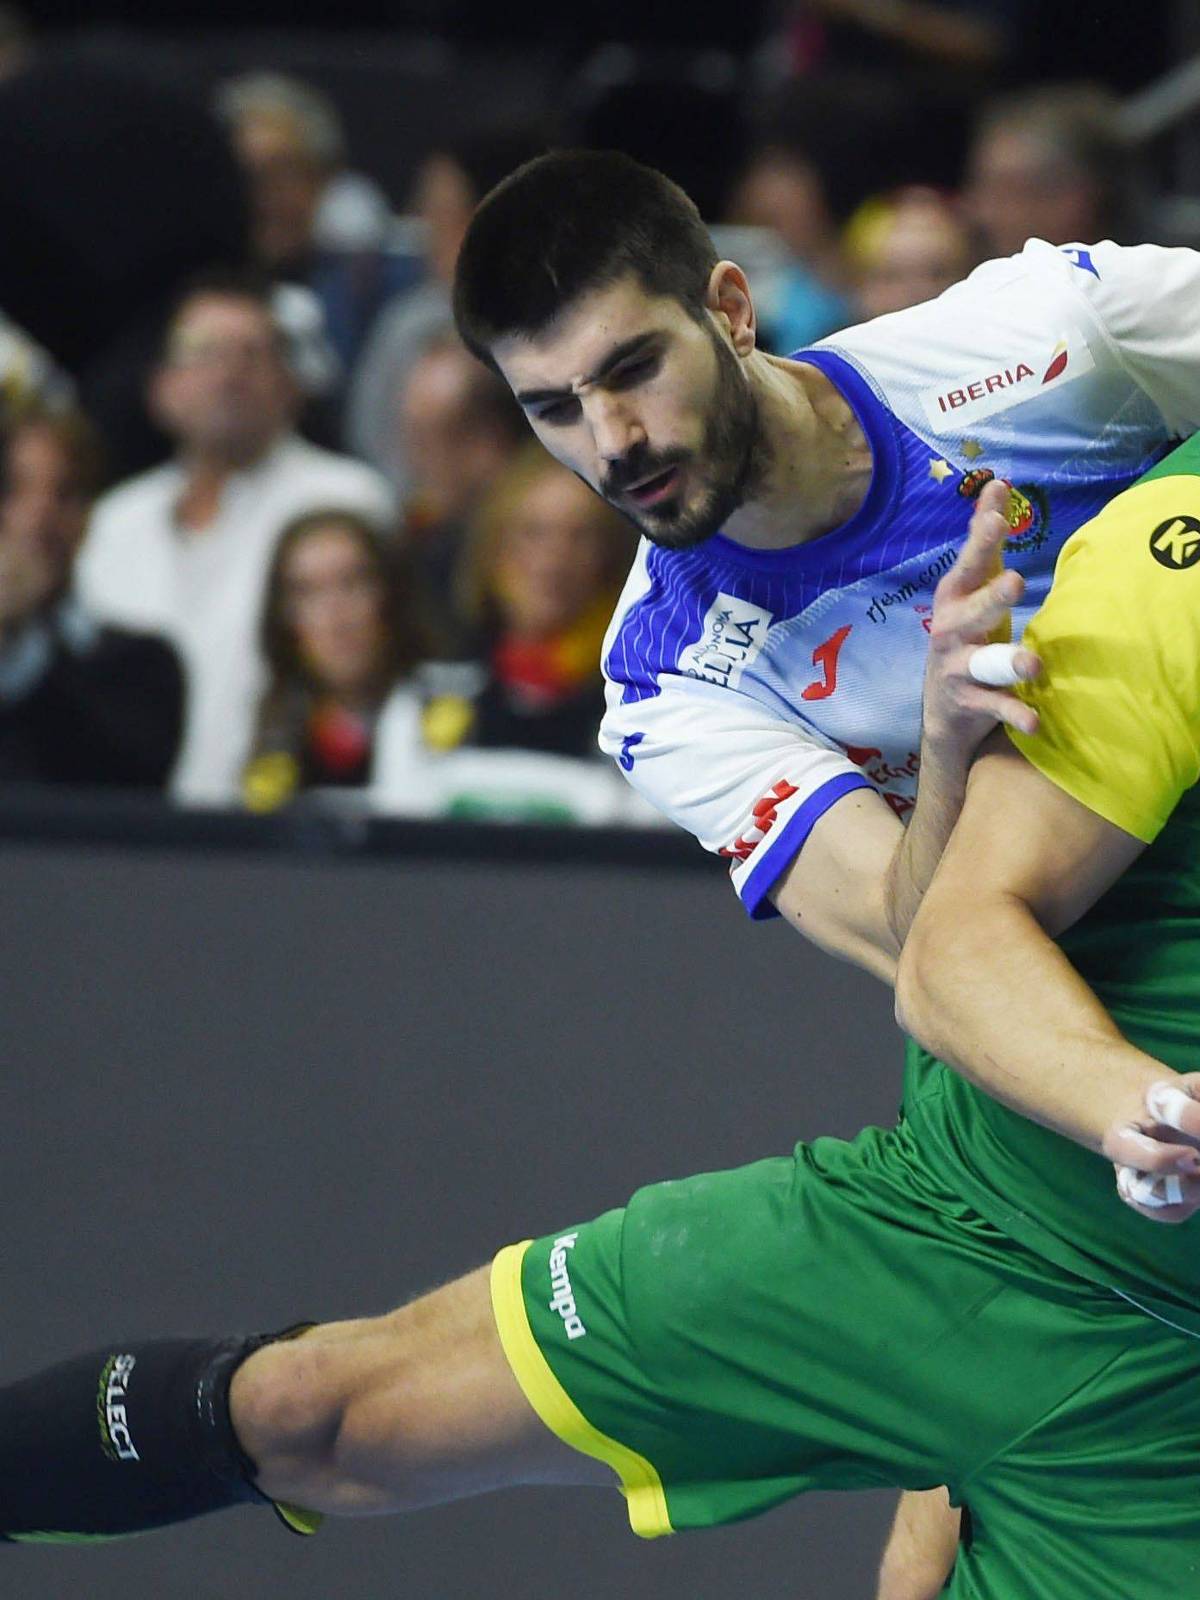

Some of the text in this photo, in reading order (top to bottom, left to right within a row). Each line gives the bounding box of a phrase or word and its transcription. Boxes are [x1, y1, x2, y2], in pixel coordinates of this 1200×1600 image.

[938, 363, 1035, 413] IBERIA
[549, 1232, 586, 1340] Kempa
[106, 1354, 140, 1460] SELECT
